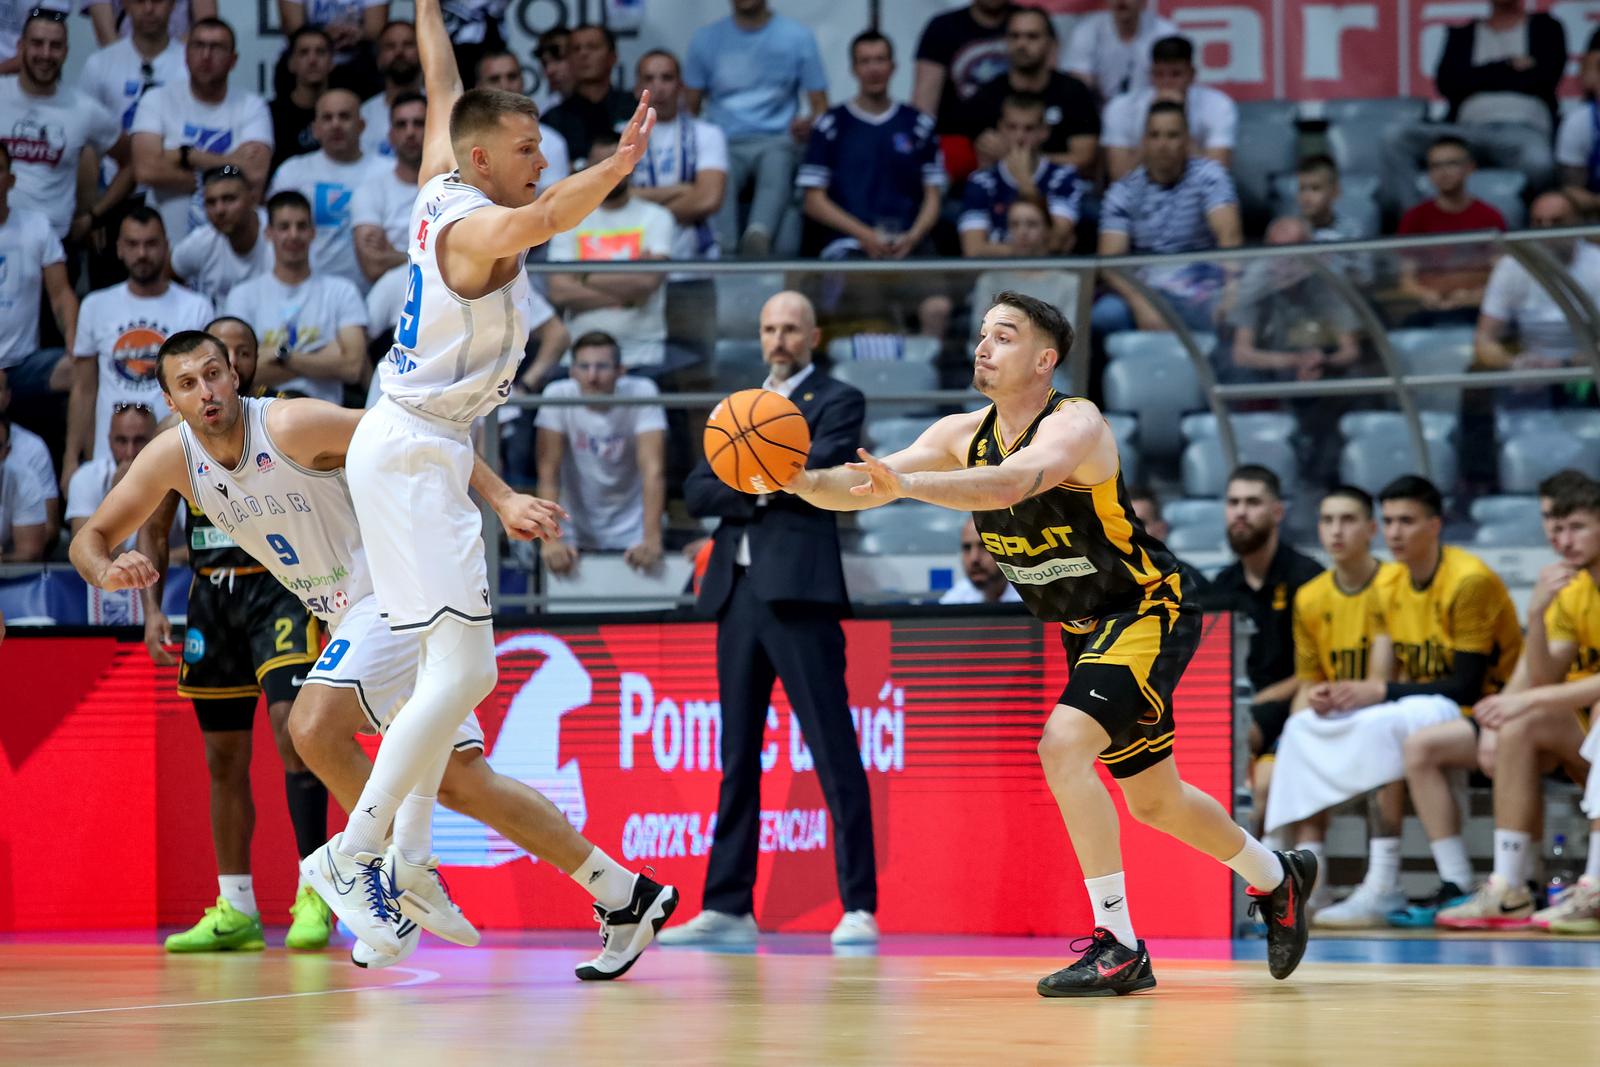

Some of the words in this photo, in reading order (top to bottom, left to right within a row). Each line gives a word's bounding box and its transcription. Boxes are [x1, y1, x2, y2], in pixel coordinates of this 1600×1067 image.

[217, 493, 311, 533] ZADAR
[265, 533, 300, 566] 9
[981, 525, 1073, 557] SPLIT
[1017, 561, 1092, 581] Groupama
[274, 616, 294, 652] 2
[315, 638, 351, 671] 9
[619, 672, 779, 772] Pom
[846, 679, 905, 773] ući
